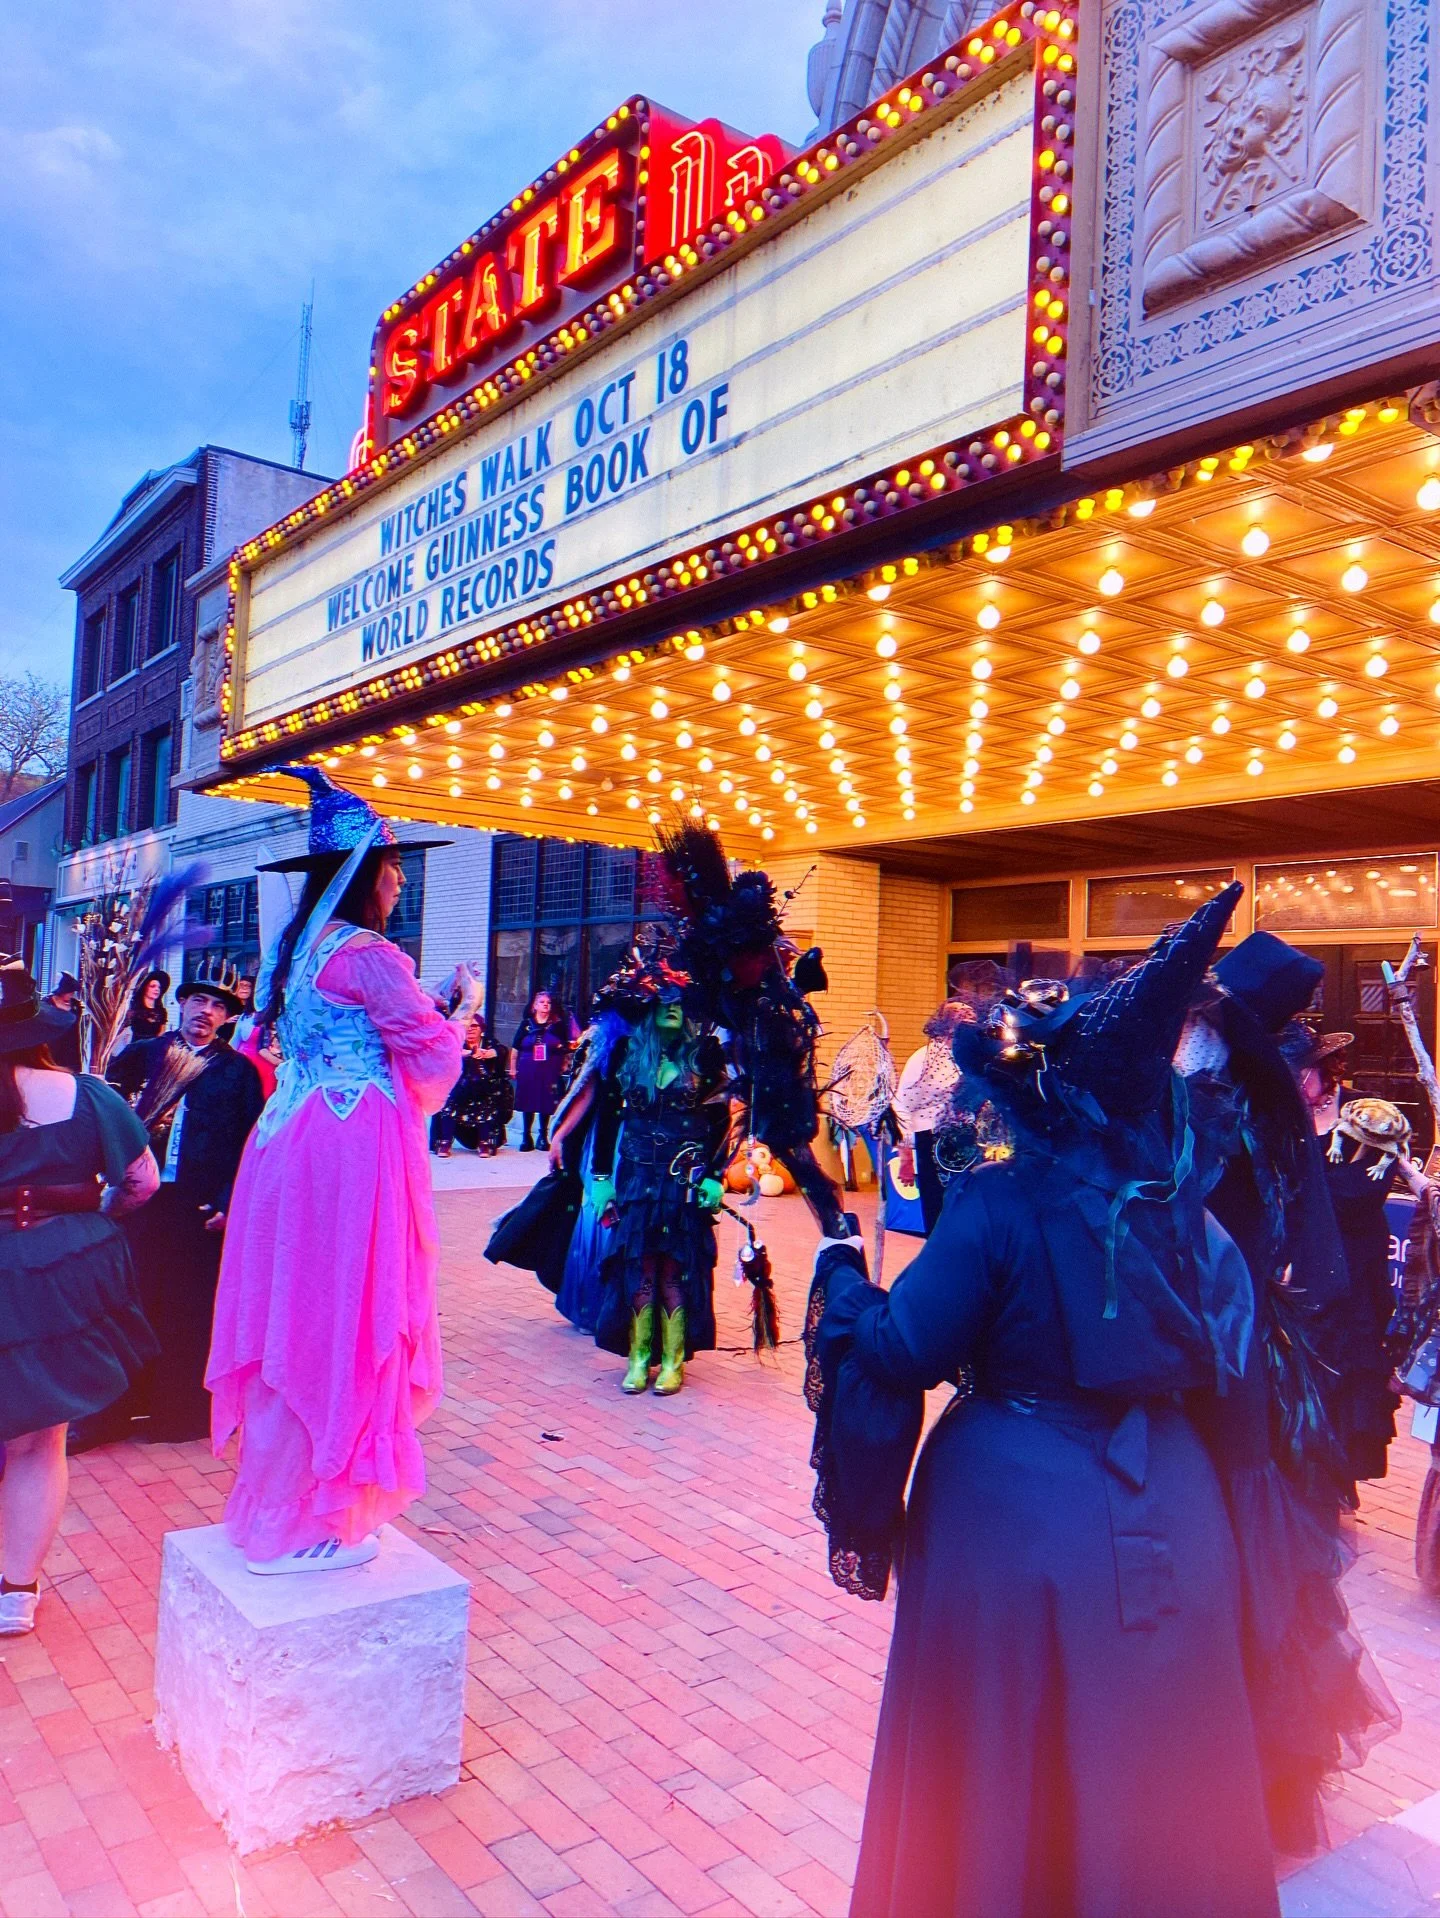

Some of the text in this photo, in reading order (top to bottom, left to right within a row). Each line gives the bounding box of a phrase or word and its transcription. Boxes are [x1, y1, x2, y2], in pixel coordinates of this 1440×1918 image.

[383, 148, 624, 417] STATE
[327, 383, 730, 632] WELCOME GUINNESS BOOK OF
[380, 340, 689, 557] WITCHES WALK OCT 18
[361, 539, 556, 662] WORLD RECORDS
